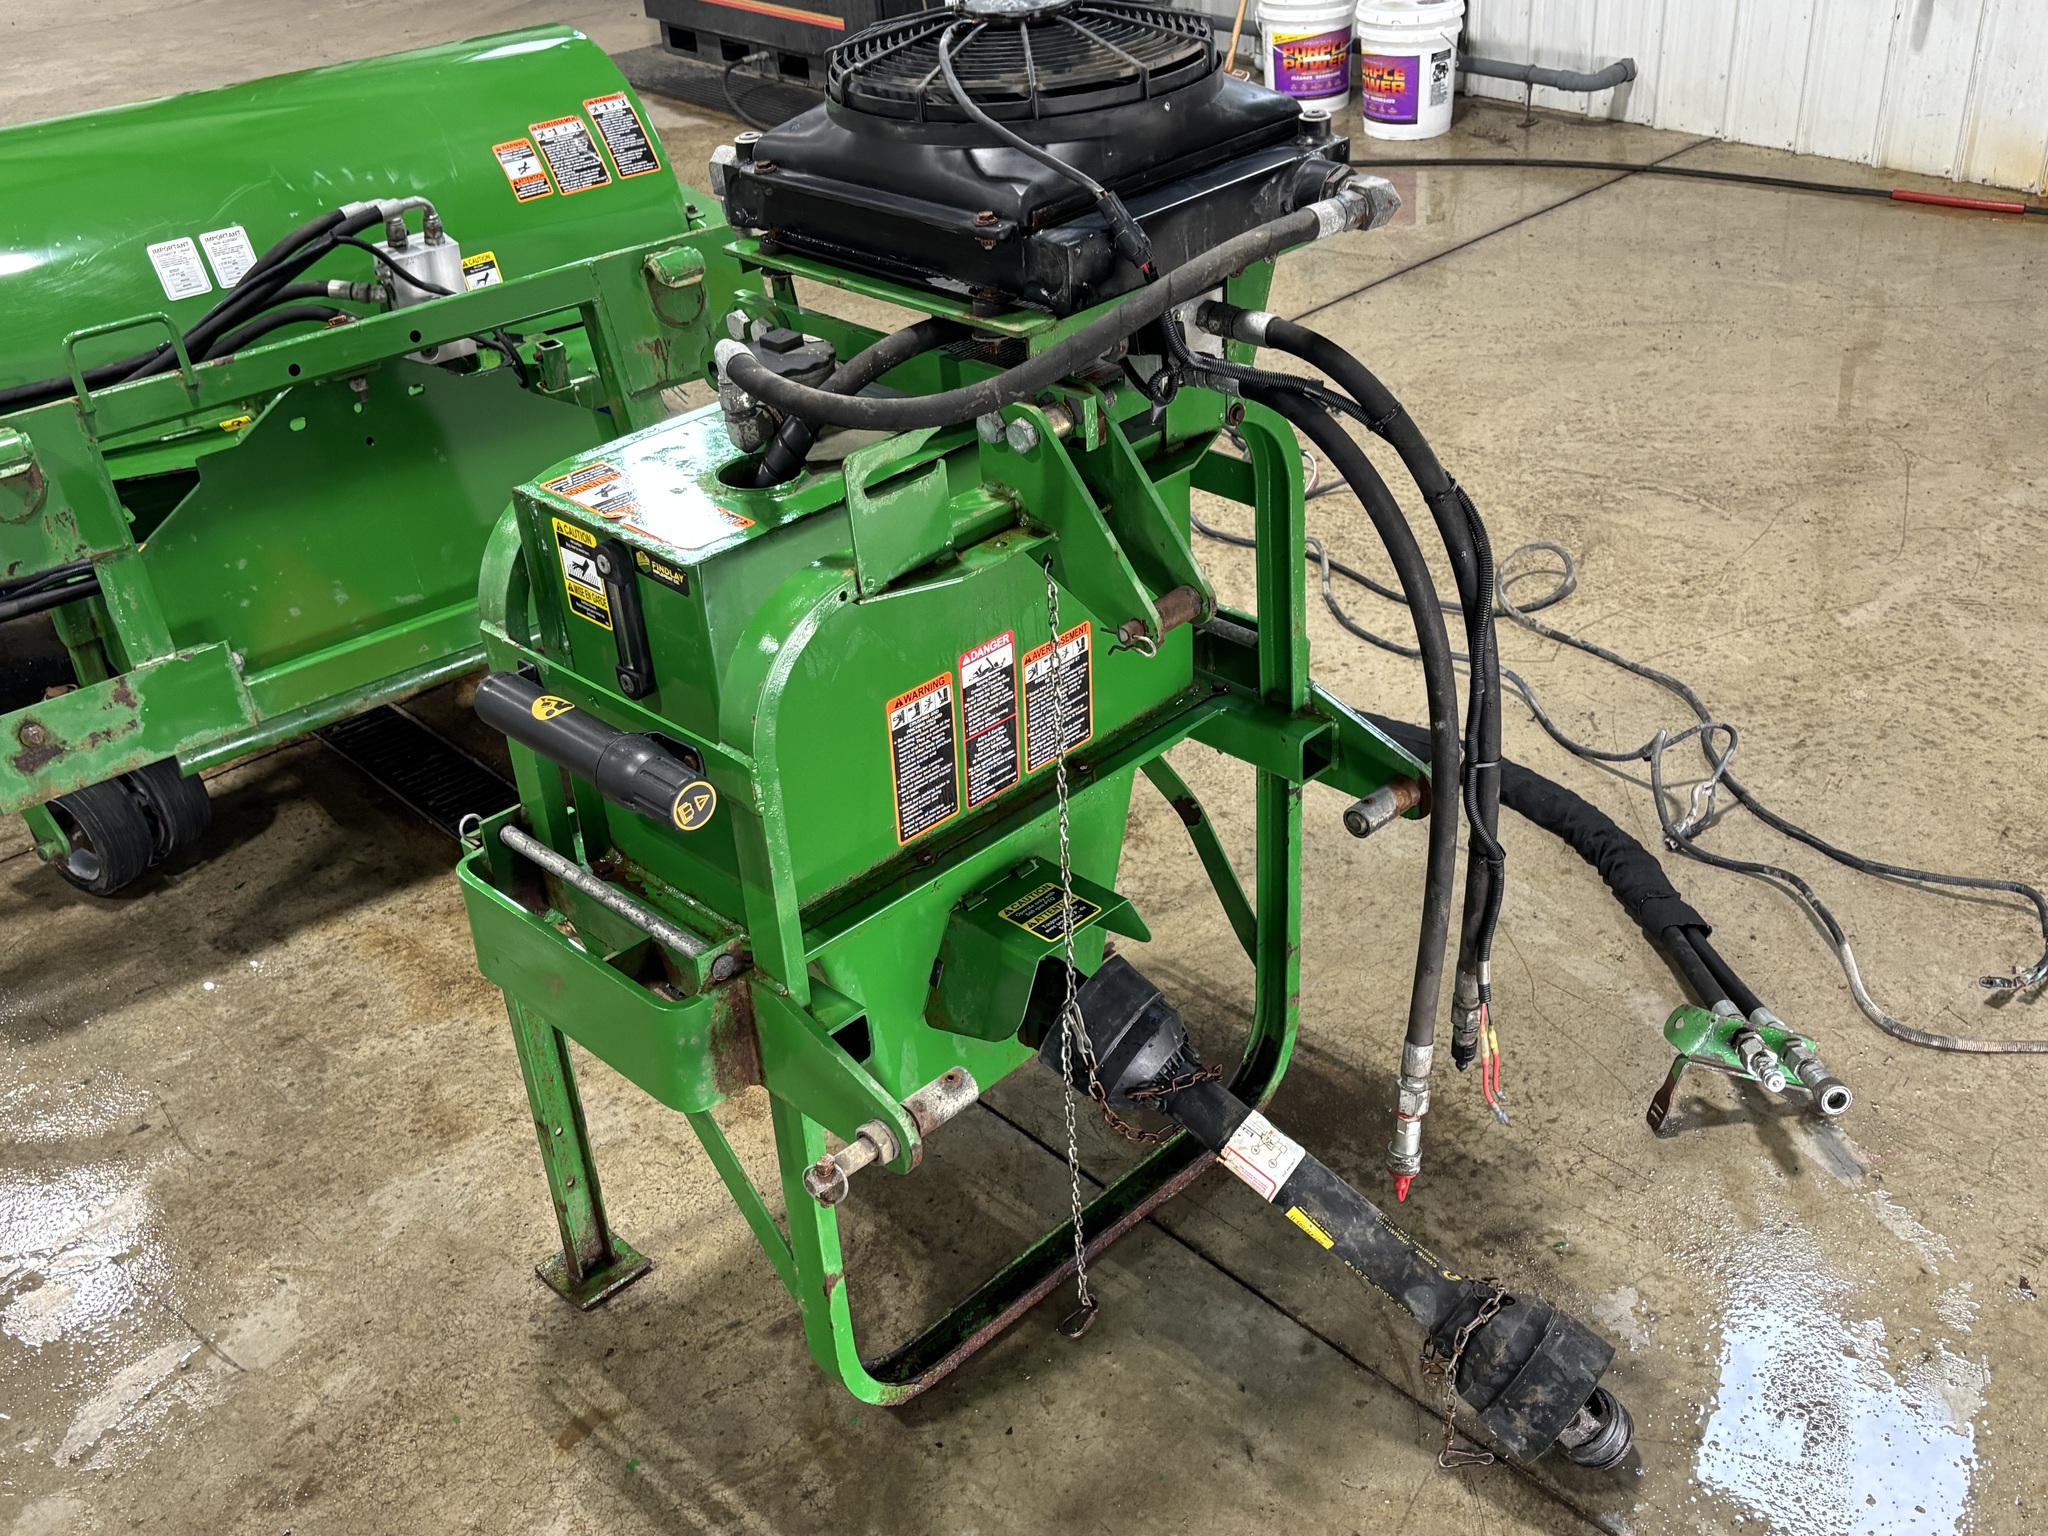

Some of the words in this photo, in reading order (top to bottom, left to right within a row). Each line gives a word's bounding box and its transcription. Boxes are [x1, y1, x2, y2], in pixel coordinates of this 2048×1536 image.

[1283, 41, 1347, 58] PURPLE
[1283, 52, 1347, 72] POWER
[1362, 75, 1406, 95] OWER
[205, 230, 241, 243] IMPORTANT
[152, 241, 190, 254] IMPORTANT
[468, 254, 491, 266] CAUTION
[563, 522, 592, 545] CAUTION
[651, 560, 684, 584] FINDLAY
[573, 582, 585, 598] MISE
[584, 588, 592, 600] EN
[591, 591, 608, 609] GARDE
[970, 633, 1010, 661] DANGER
[1032, 623, 1088, 661] AVERSEMENT
[903, 676, 946, 704] WARNING
[1011, 883, 1052, 910] CAUTION
[1044, 896, 1056, 905] PTO
